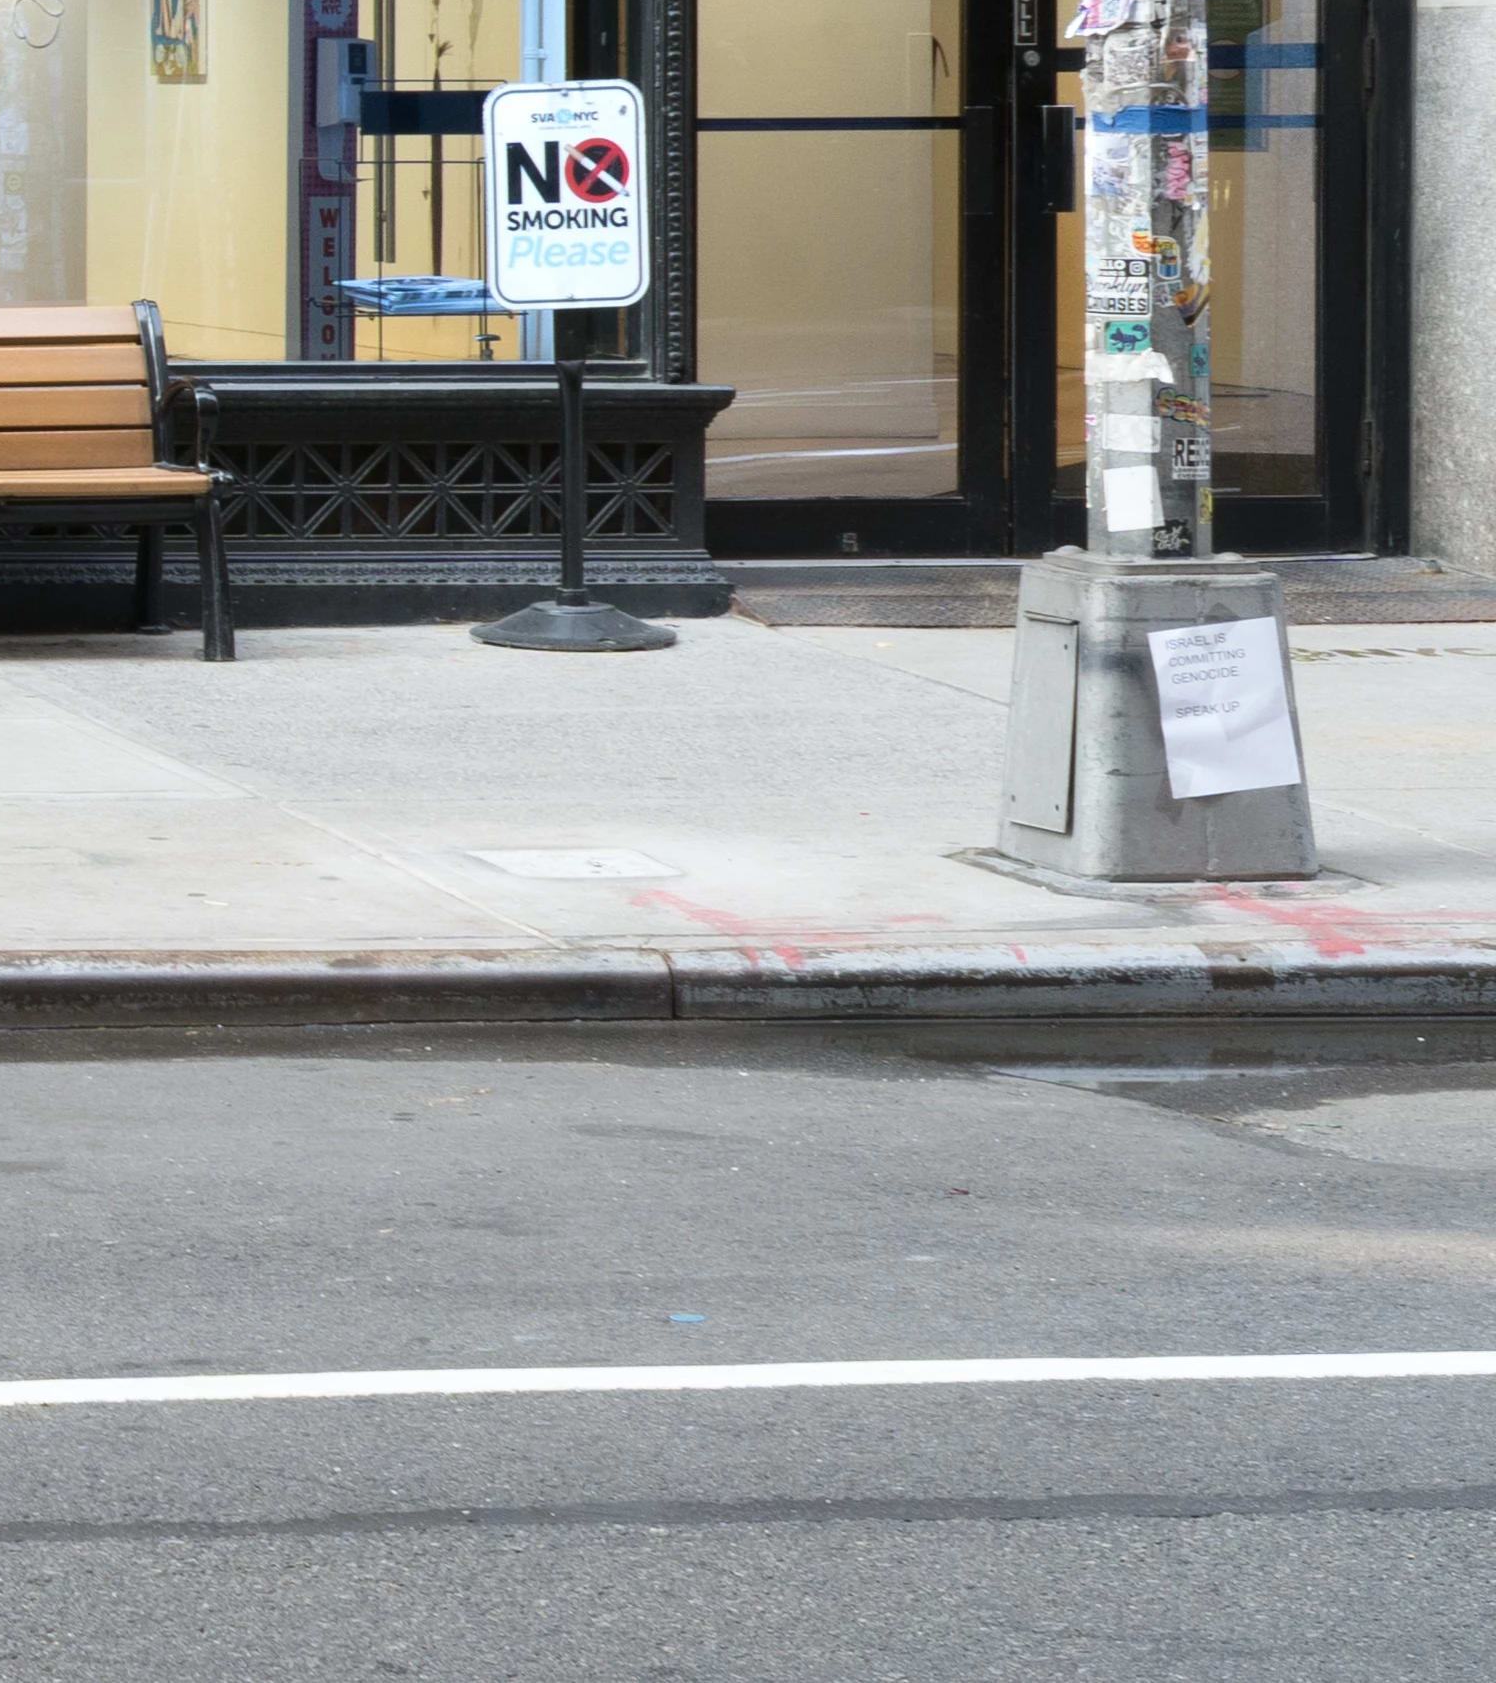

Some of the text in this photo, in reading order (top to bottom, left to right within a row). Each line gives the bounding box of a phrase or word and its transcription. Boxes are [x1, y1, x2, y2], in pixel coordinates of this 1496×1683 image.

[531, 111, 598, 123] SVA NYC
[507, 207, 629, 231] SMOKING
[508, 236, 630, 269] Please
[1166, 633, 1226, 649] ISRAEL IS
[1168, 649, 1246, 667] COMMITTING
[1172, 666, 1239, 684] GENOCIDE
[1176, 701, 1240, 719] SPEAK UP
